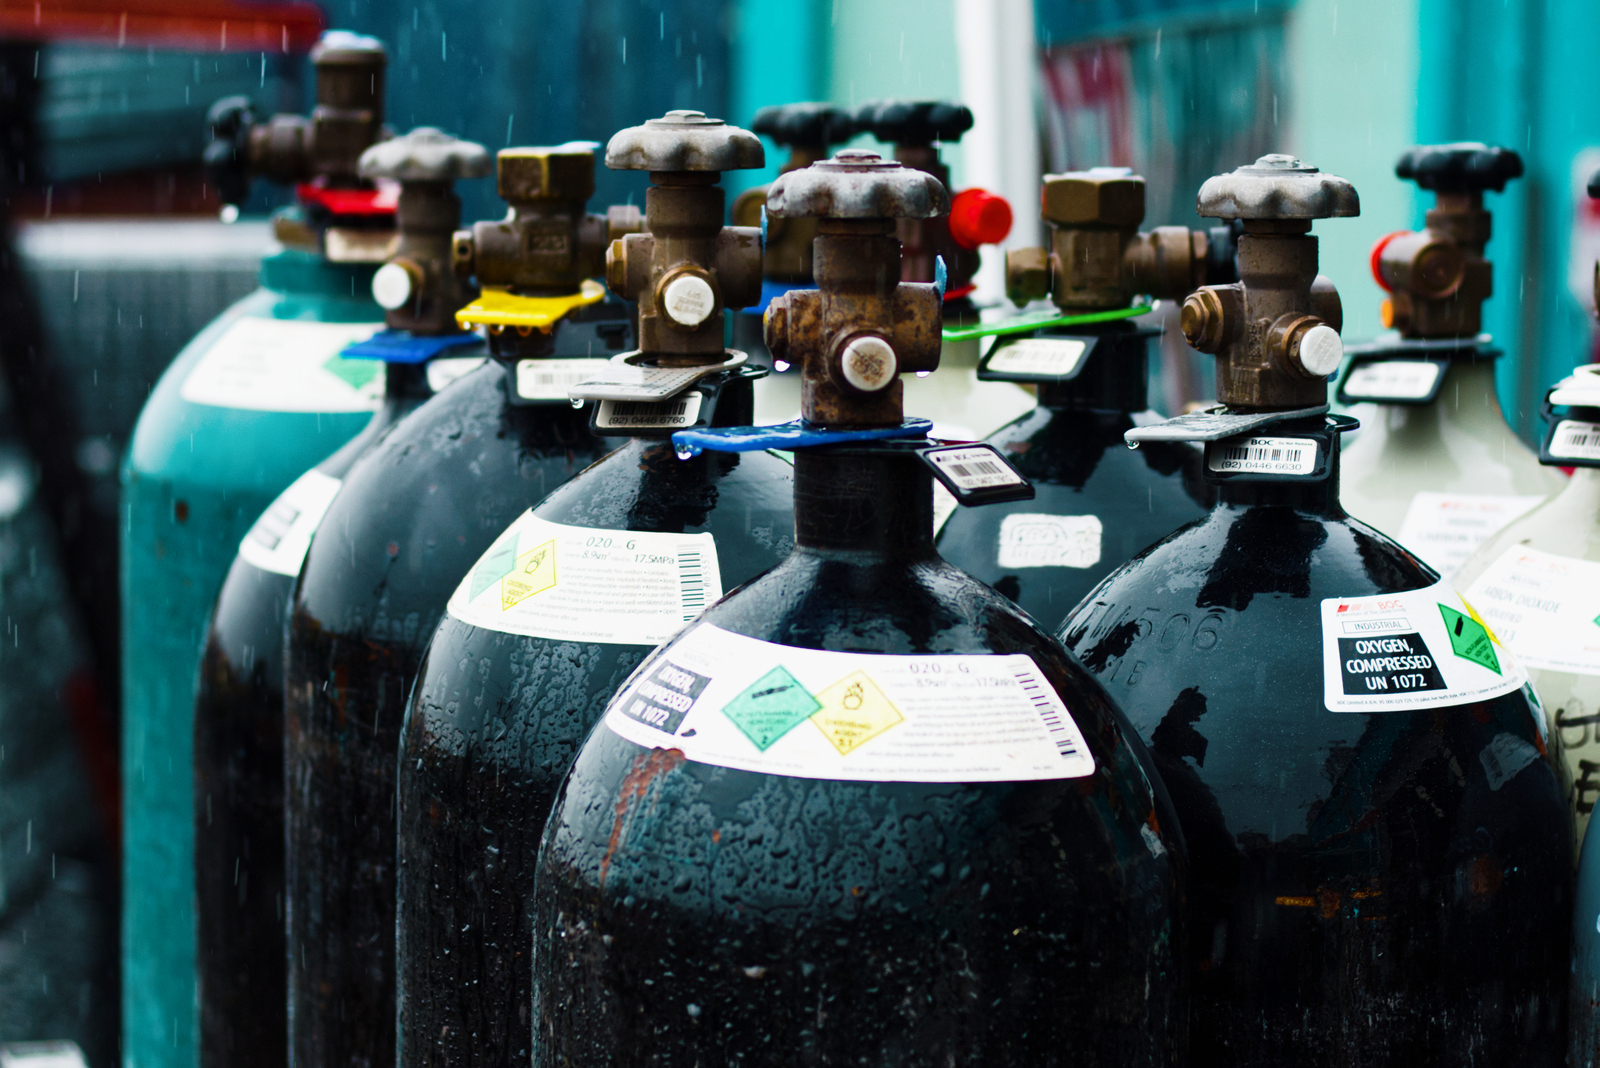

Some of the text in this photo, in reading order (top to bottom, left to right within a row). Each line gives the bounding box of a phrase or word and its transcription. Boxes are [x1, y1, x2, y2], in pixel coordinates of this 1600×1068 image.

[608, 416, 686, 425] (92) 0446 6760
[1221, 460, 1242, 470] (92)
[586, 536, 613, 548] 020
[626, 540, 636, 550] G
[634, 554, 674, 564] 17.5MPa
[1376, 600, 1404, 610] BOC
[1478, 584, 1563, 614] CARBON DIOXIDE
[1354, 620, 1404, 631] INDUSTRIAL
[1355, 638, 1414, 654] OXYGEN,
[909, 662, 941, 674] 020
[958, 662, 970, 674] G
[1346, 655, 1432, 674] COMPRESSED
[1364, 674, 1428, 690] UN 1072
[630, 698, 670, 726] UN 1072
